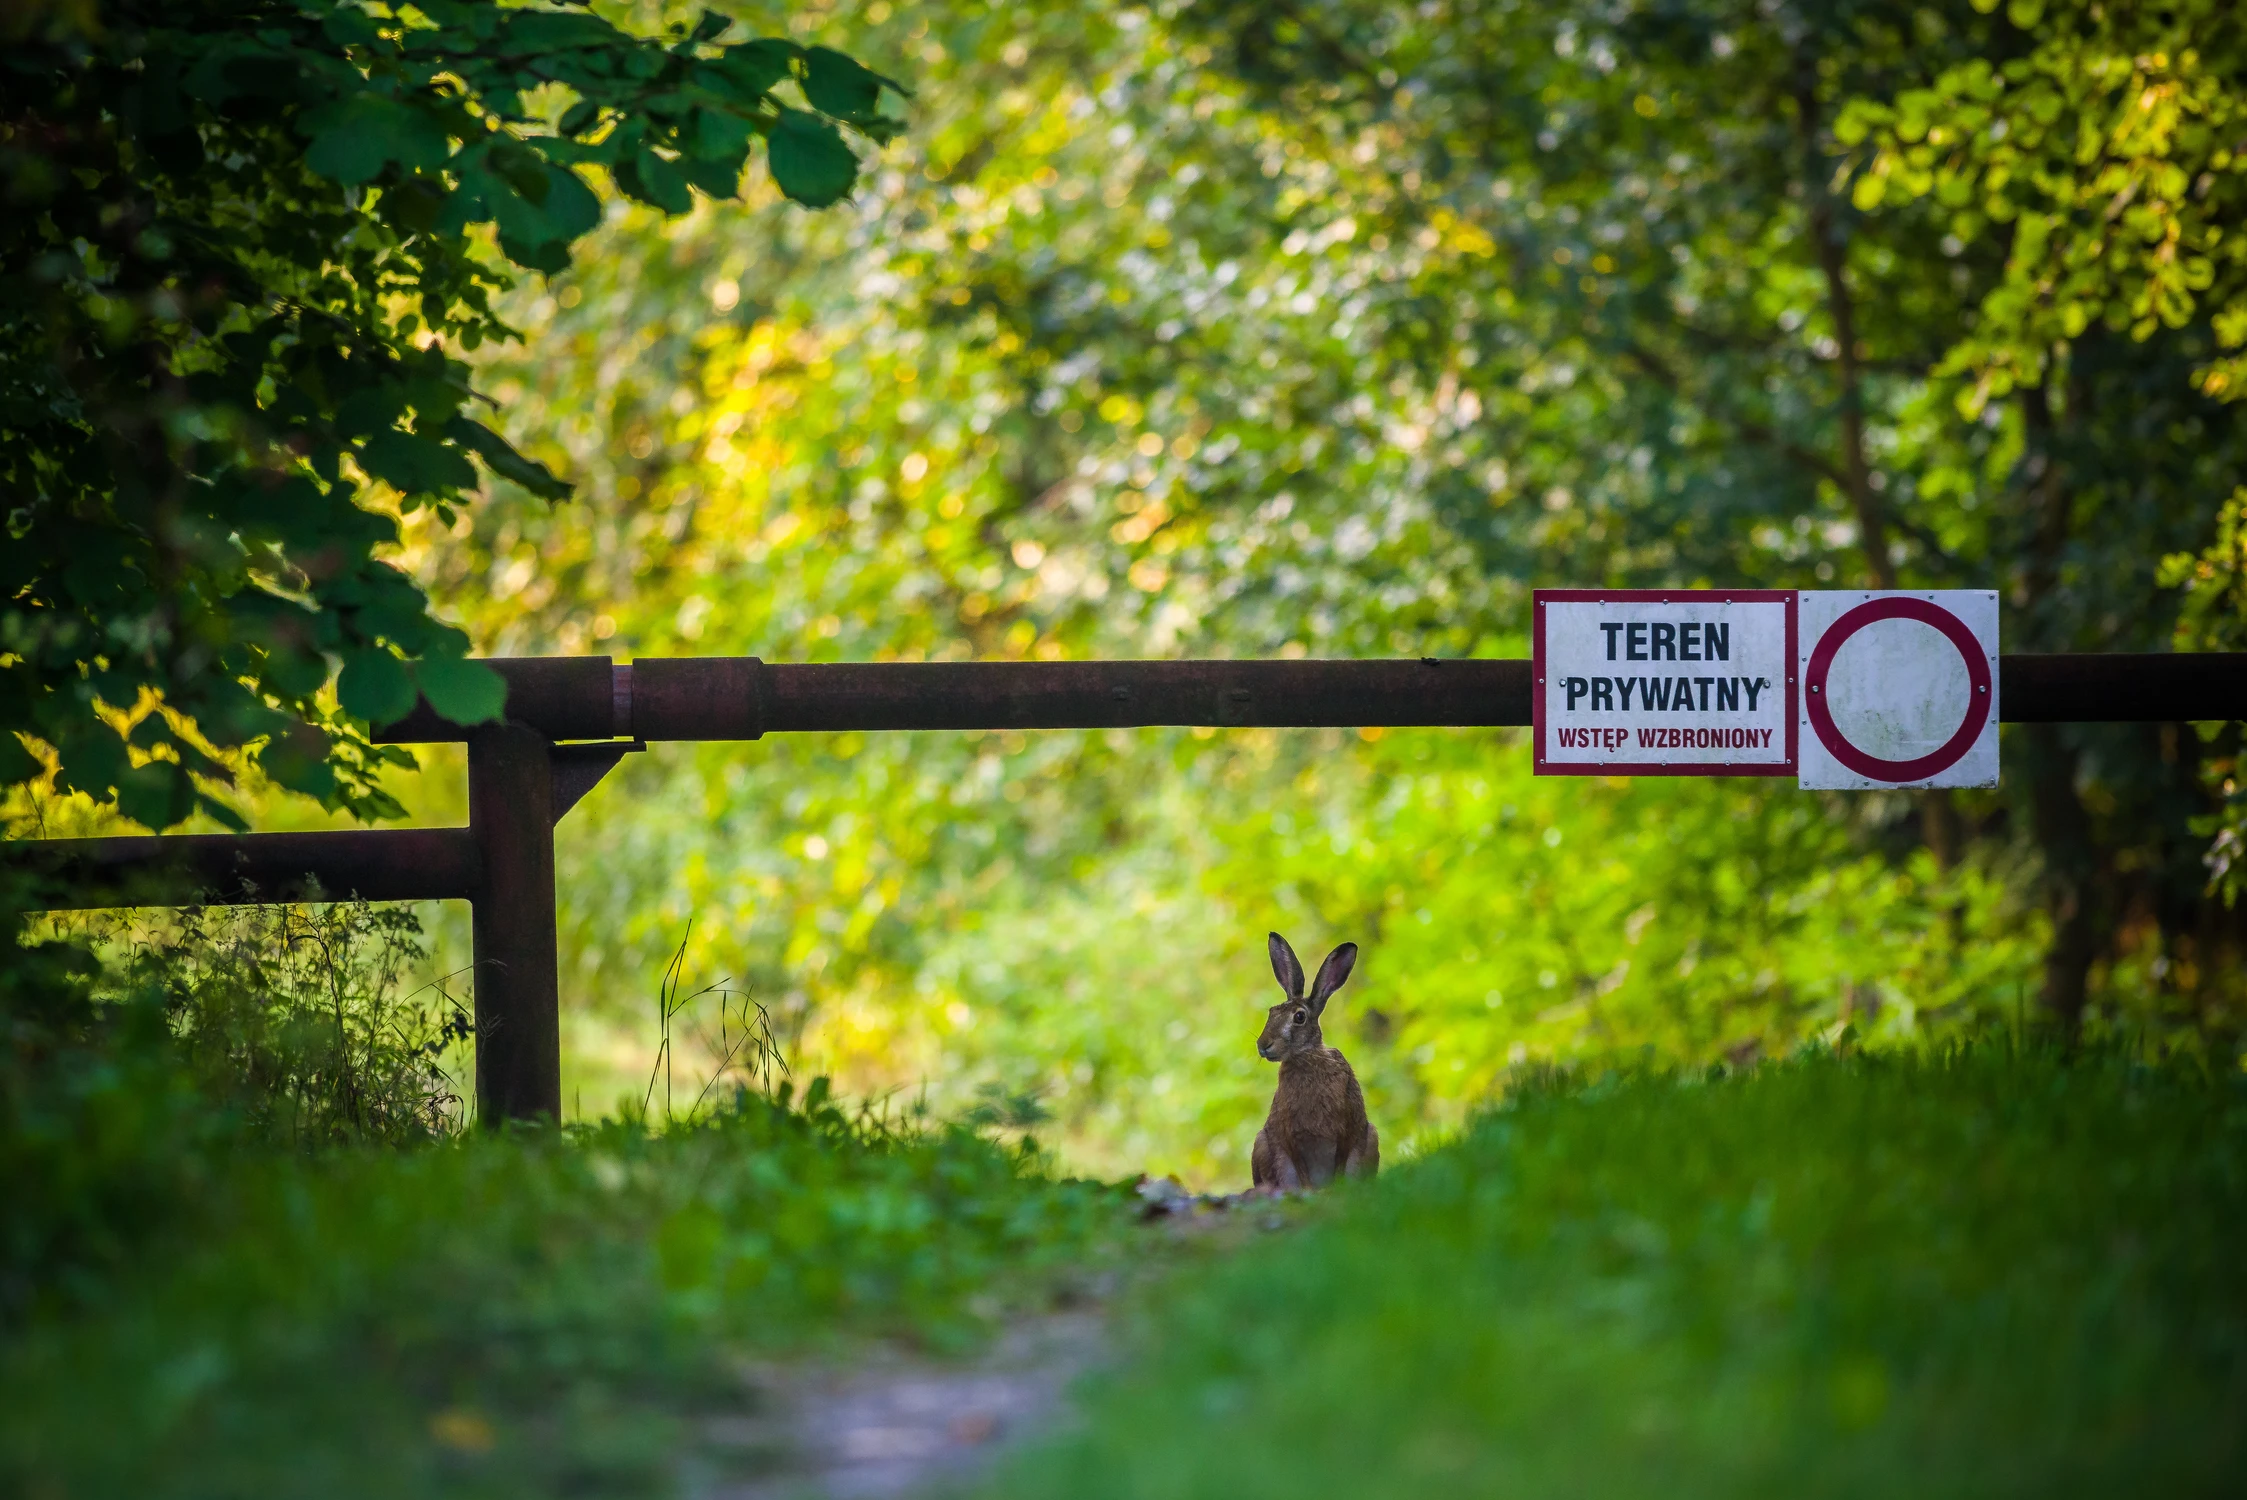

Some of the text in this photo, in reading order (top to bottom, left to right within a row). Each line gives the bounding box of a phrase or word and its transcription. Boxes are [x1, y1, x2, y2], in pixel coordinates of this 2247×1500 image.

[1600, 622, 1730, 661] TEREN
[1566, 677, 1764, 711] PRYWATNY
[1558, 728, 1773, 752] WSTĘP WZBRONIONY
